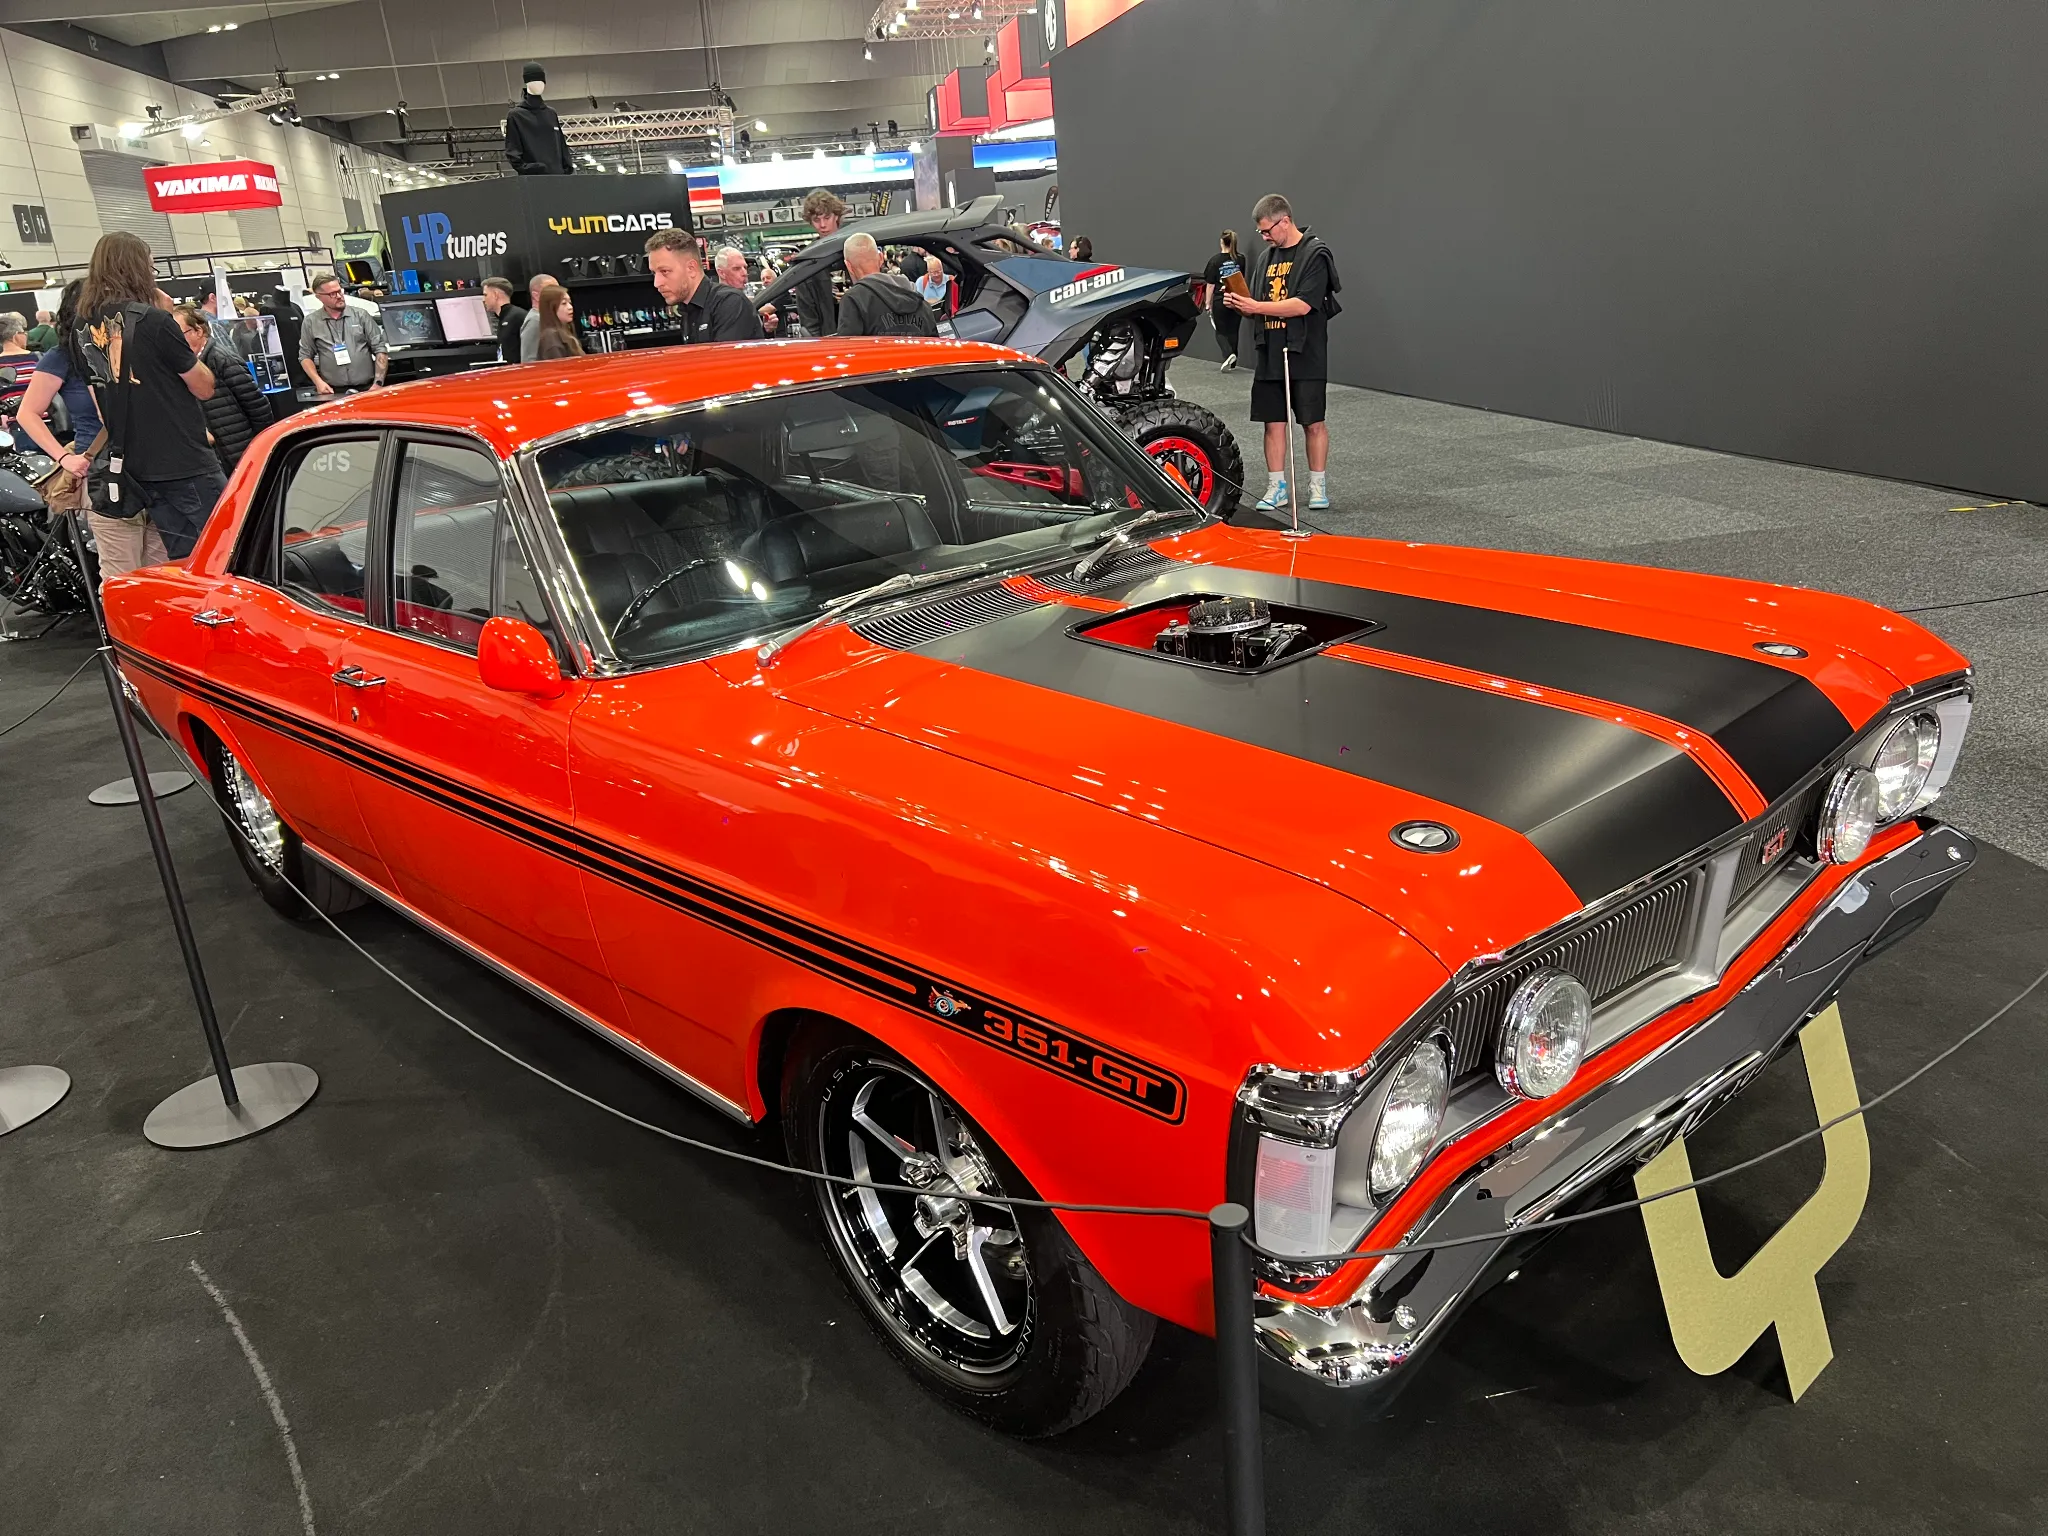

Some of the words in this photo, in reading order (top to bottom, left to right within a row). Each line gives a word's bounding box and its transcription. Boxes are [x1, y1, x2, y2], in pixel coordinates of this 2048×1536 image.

[154, 174, 247, 197] YAKIMA
[548, 212, 673, 235] YUMCARS
[1049, 268, 1125, 304] can-am
[983, 1010, 1162, 1099] 351-GT
[869, 1277, 959, 1368] FORGED
